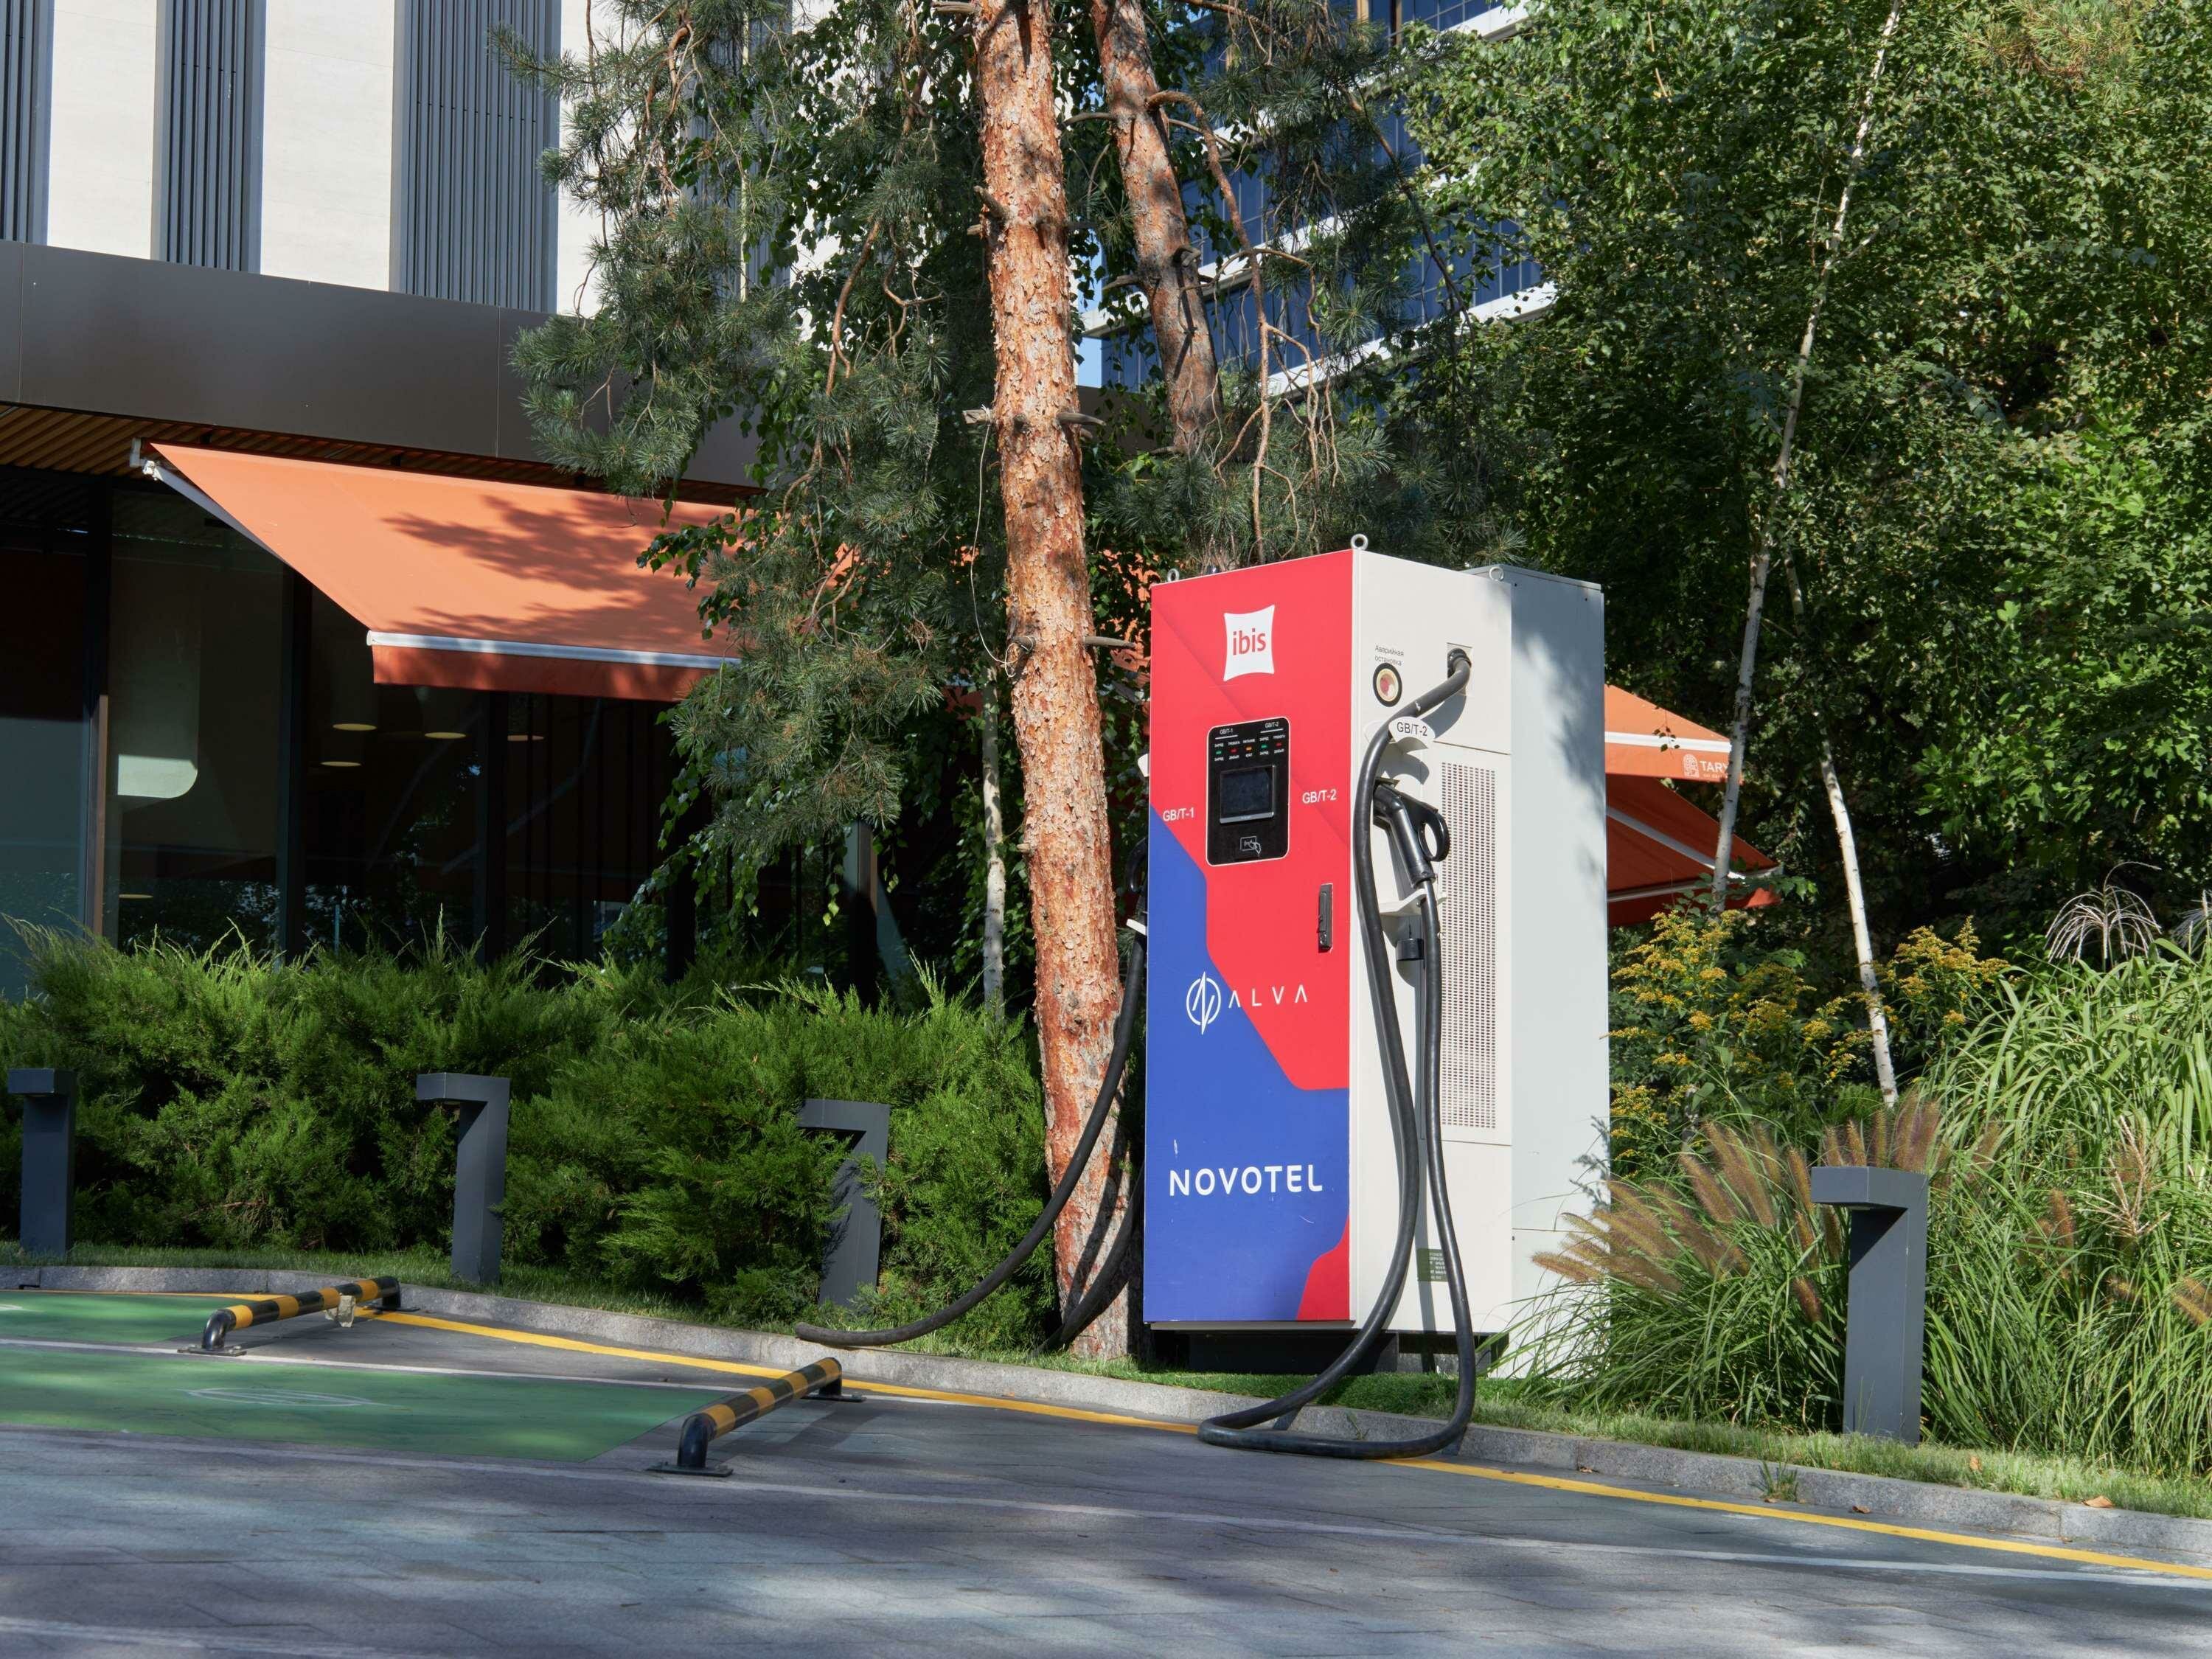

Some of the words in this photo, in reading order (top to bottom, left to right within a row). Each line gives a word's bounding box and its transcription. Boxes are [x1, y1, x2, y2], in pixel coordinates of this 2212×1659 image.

[1232, 627, 1267, 655] ibis
[1374, 644, 1404, 656] Аварийная
[1397, 721, 1427, 737] GB/T-2
[1301, 788, 1337, 804] GB/T-2
[1162, 807, 1194, 822] GB/T-1
[1228, 984, 1308, 1009] ALVA
[1169, 1164, 1323, 1197] NOVOTEL
